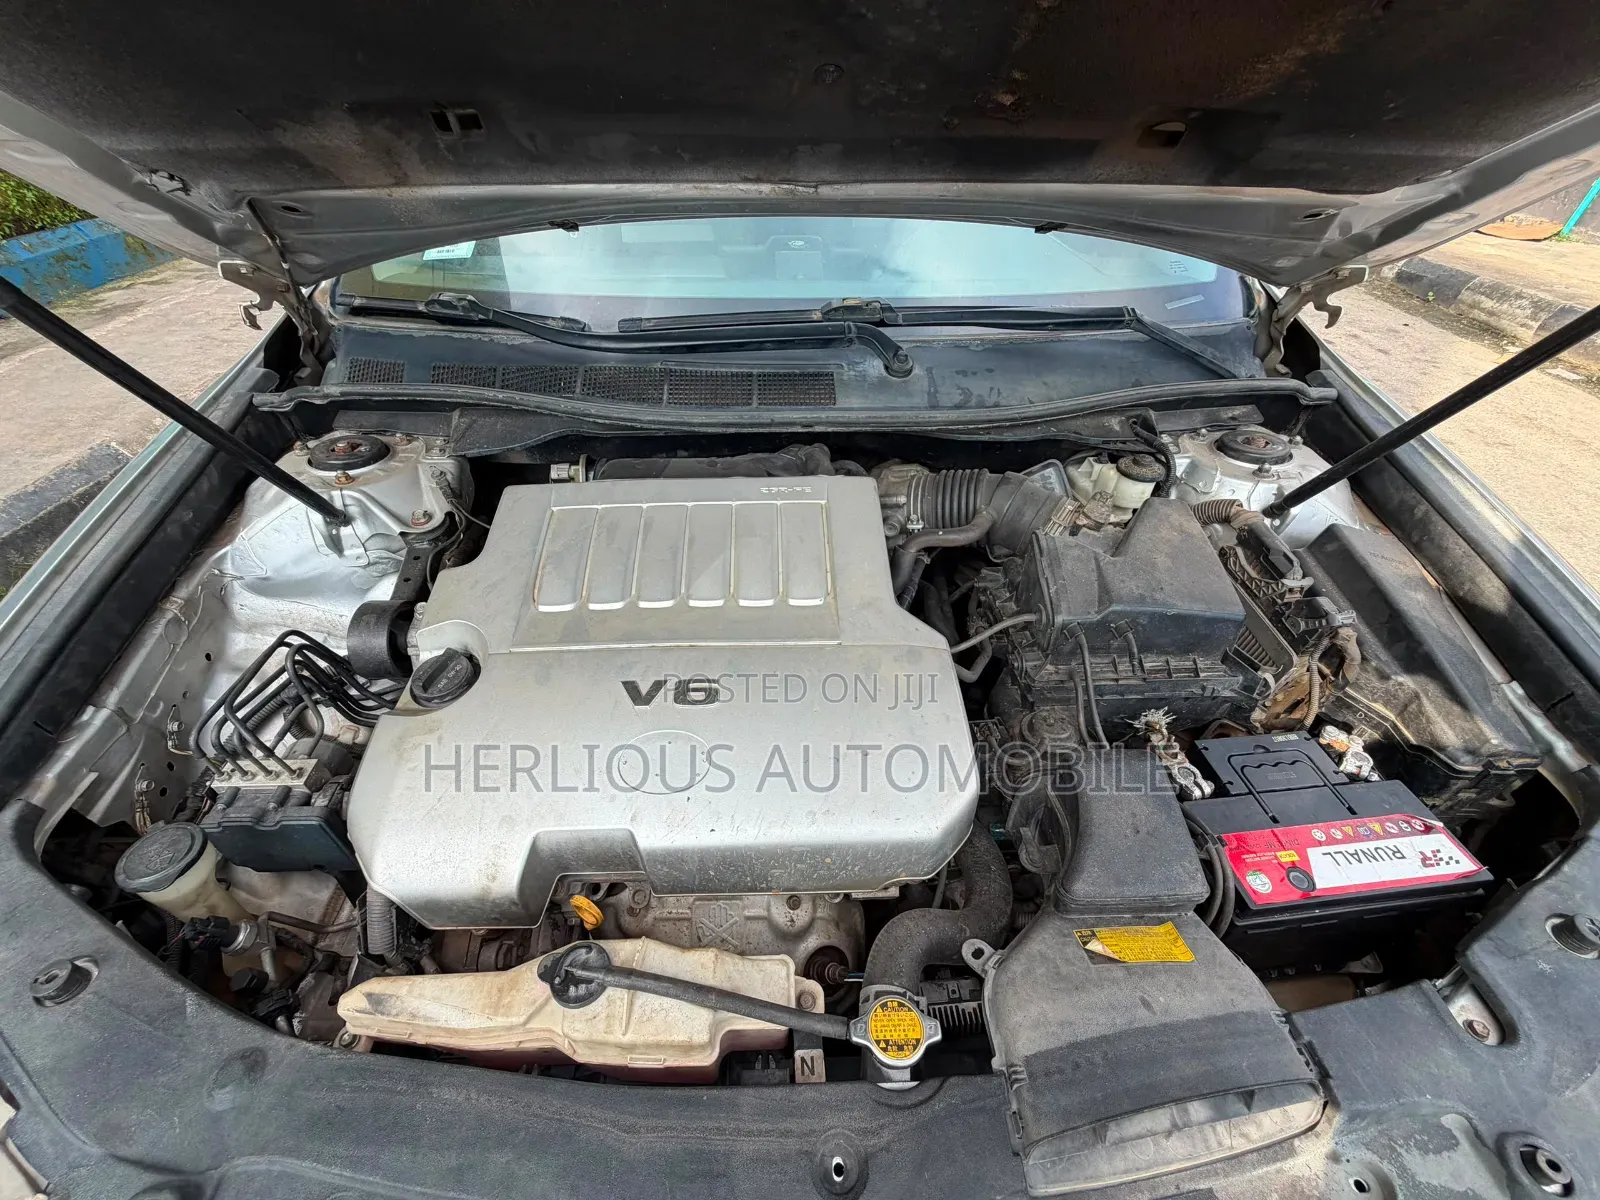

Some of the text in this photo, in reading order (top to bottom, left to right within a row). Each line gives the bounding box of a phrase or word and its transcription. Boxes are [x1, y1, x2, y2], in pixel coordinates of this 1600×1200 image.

[620, 678, 720, 709] V6
[1322, 844, 1407, 867] RUNALL
[800, 1055, 816, 1077] N
